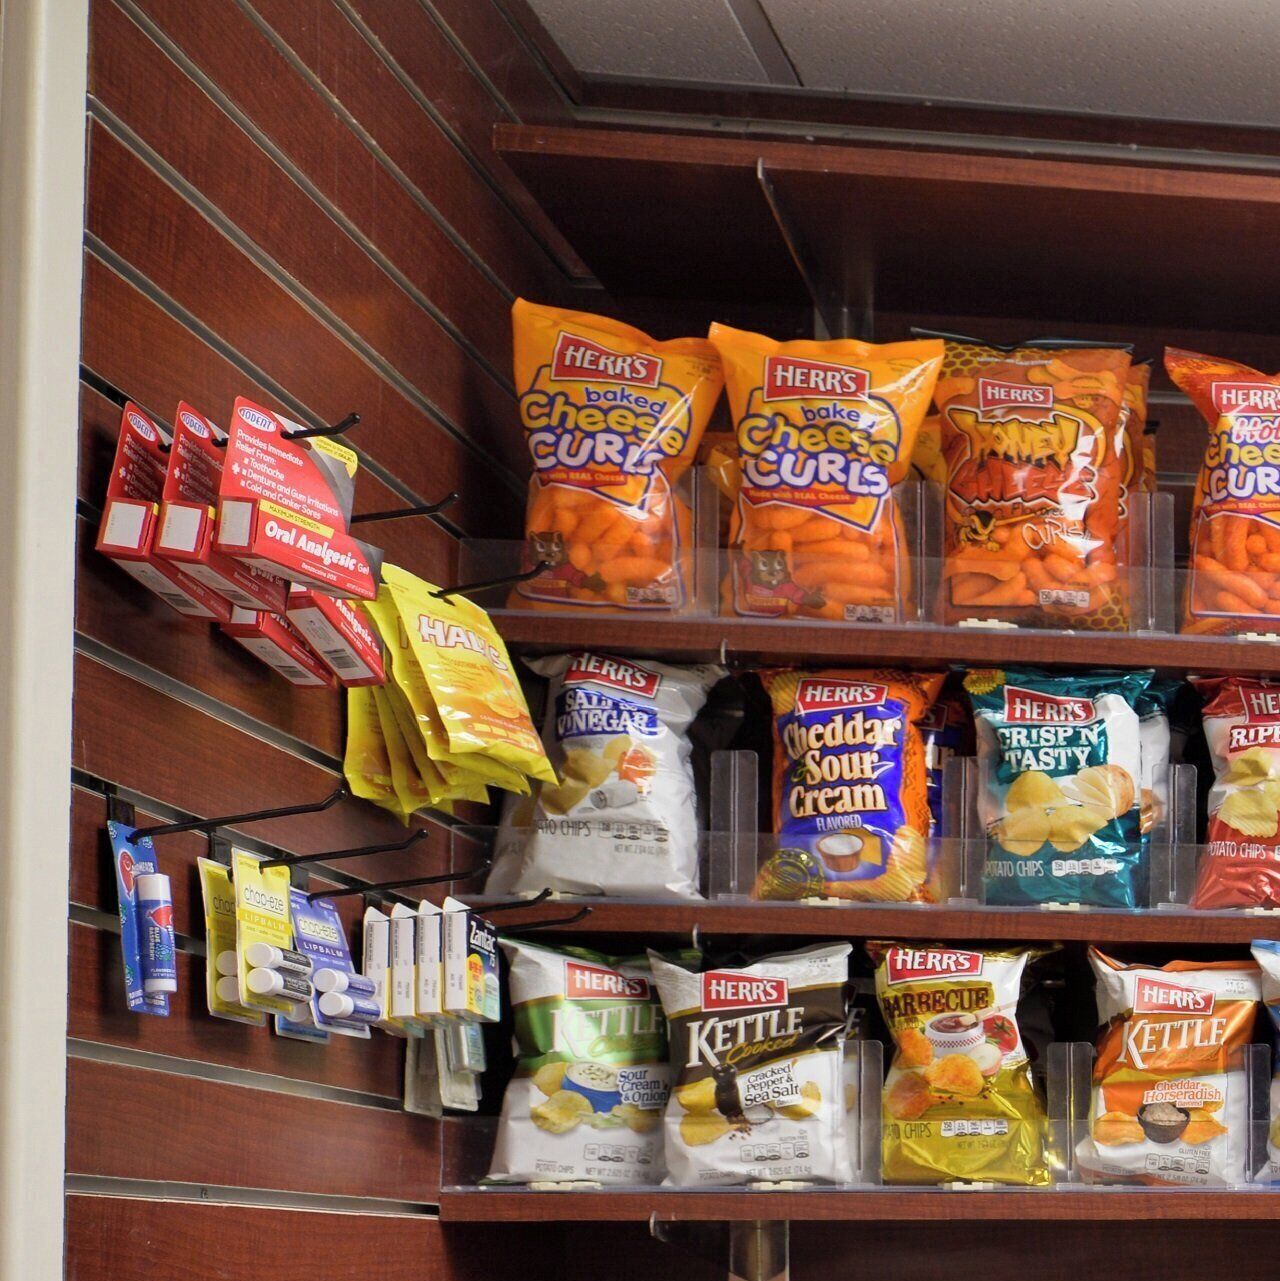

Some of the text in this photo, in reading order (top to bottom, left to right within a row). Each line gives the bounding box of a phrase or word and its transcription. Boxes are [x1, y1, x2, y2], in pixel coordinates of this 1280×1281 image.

[564, 344, 649, 378] HERR'S
[773, 363, 858, 393] HERR'S
[585, 387, 668, 416] baked
[520, 392, 685, 458] Cheese
[738, 414, 896, 464] Cheese
[235, 441, 277, 466] Relief From:
[237, 429, 304, 466] Provides Immediate
[249, 458, 285, 481] Toothache
[746, 453, 888, 496] CURLS
[247, 469, 339, 517] Denture and Gum Irritations
[247, 481, 321, 520] Cold and Canker Sores
[269, 505, 320, 531] MAXIMUM STRENGTH
[265, 520, 370, 575] Oral Analgesic Gel
[556, 709, 649, 735] VINEGAR
[782, 713, 902, 757] Cheddar
[1004, 748, 1092, 771] TASTY
[789, 784, 888, 819] Cream
[816, 815, 862, 831] FLAVORED
[244, 913, 286, 931] LIPBALM
[469, 919, 497, 953] Zantac
[304, 942, 344, 958] LIPBALM
[893, 951, 972, 973] HERR'S
[709, 979, 778, 1002] HERR'S
[882, 986, 990, 1019] BARBECUE
[1142, 985, 1205, 1009] HERR'S
[686, 1007, 806, 1069] KETTLE
[1117, 1018, 1227, 1070] KETTLE
[747, 1063, 792, 1085] Cracked
[1156, 1080, 1201, 1092] Cheddar
[744, 1083, 799, 1108] Sea Salt
[1145, 1086, 1222, 1105] Horseradish
